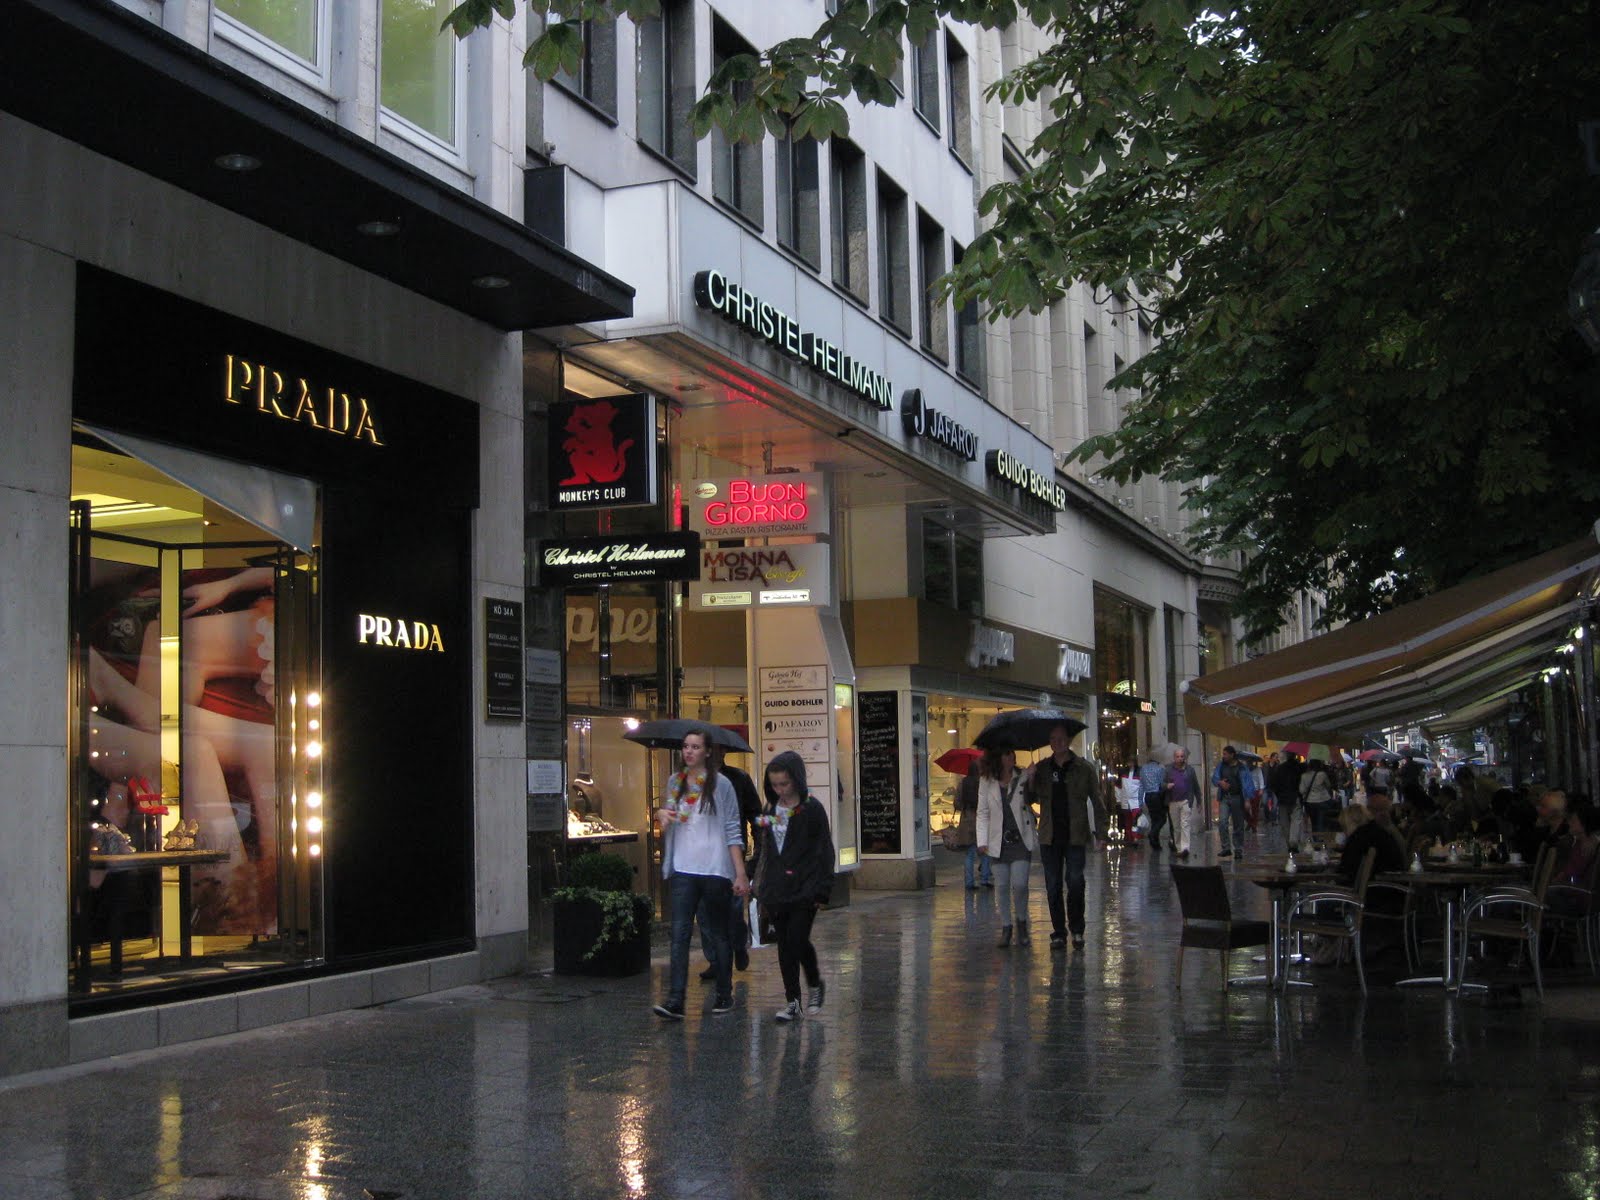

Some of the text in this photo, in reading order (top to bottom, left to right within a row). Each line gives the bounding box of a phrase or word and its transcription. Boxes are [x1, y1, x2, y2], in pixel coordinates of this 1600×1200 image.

[708, 269, 893, 411] CHRISTEL HEILMANN
[225, 354, 385, 446] PRADA
[930, 408, 979, 461] JAFAROV
[729, 480, 805, 504] BUON
[997, 449, 1066, 512] GUIDO BOEHLER
[559, 487, 626, 502] MONKEY'S CLUB
[704, 501, 808, 525] GIORNO
[705, 523, 808, 536] PIZZA PASTA RISTORANTE
[544, 543, 686, 566] Christel Heilmann
[703, 550, 796, 571] MONNA
[613, 569, 656, 577] HEILMANN
[708, 566, 770, 587] LISA
[358, 613, 445, 653] PRADA
[764, 698, 824, 708] GUIDO BOEHLER
[778, 719, 824, 728] JAFAROV
